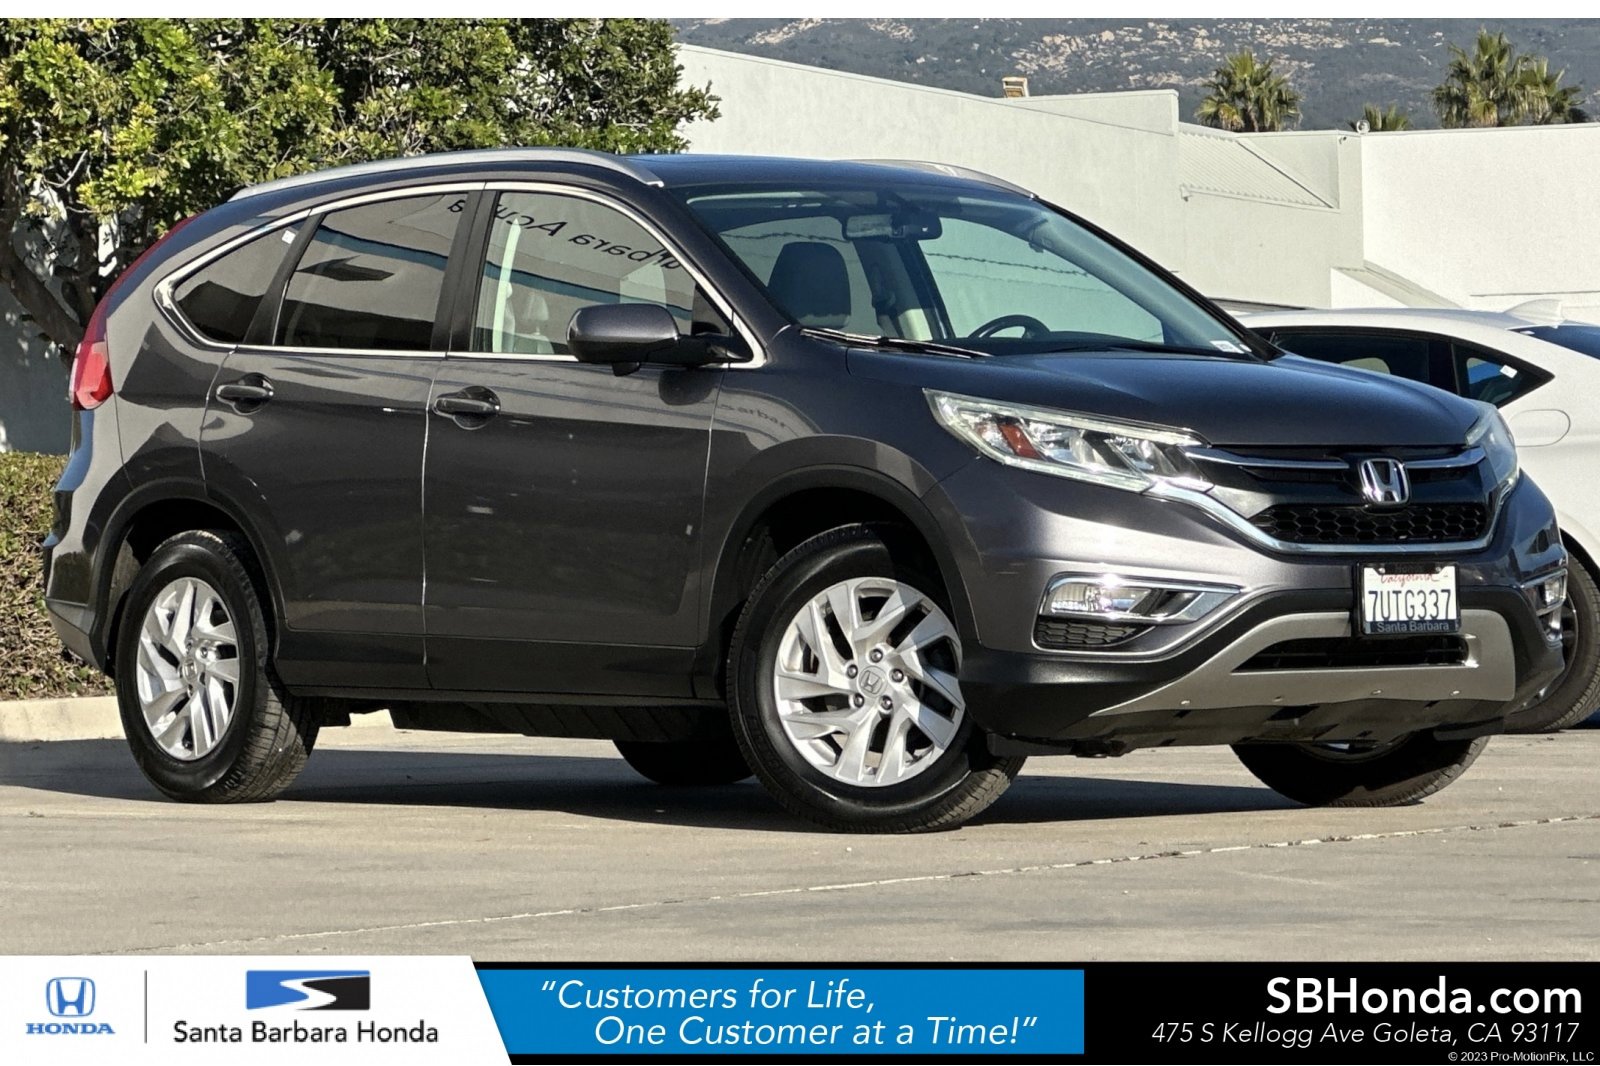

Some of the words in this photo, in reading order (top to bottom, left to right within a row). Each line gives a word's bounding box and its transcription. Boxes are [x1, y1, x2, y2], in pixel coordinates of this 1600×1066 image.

[1368, 589, 1452, 622] 7UTG337
[1376, 621, 1406, 633] Santa
[1408, 620, 1450, 632] Barbara
